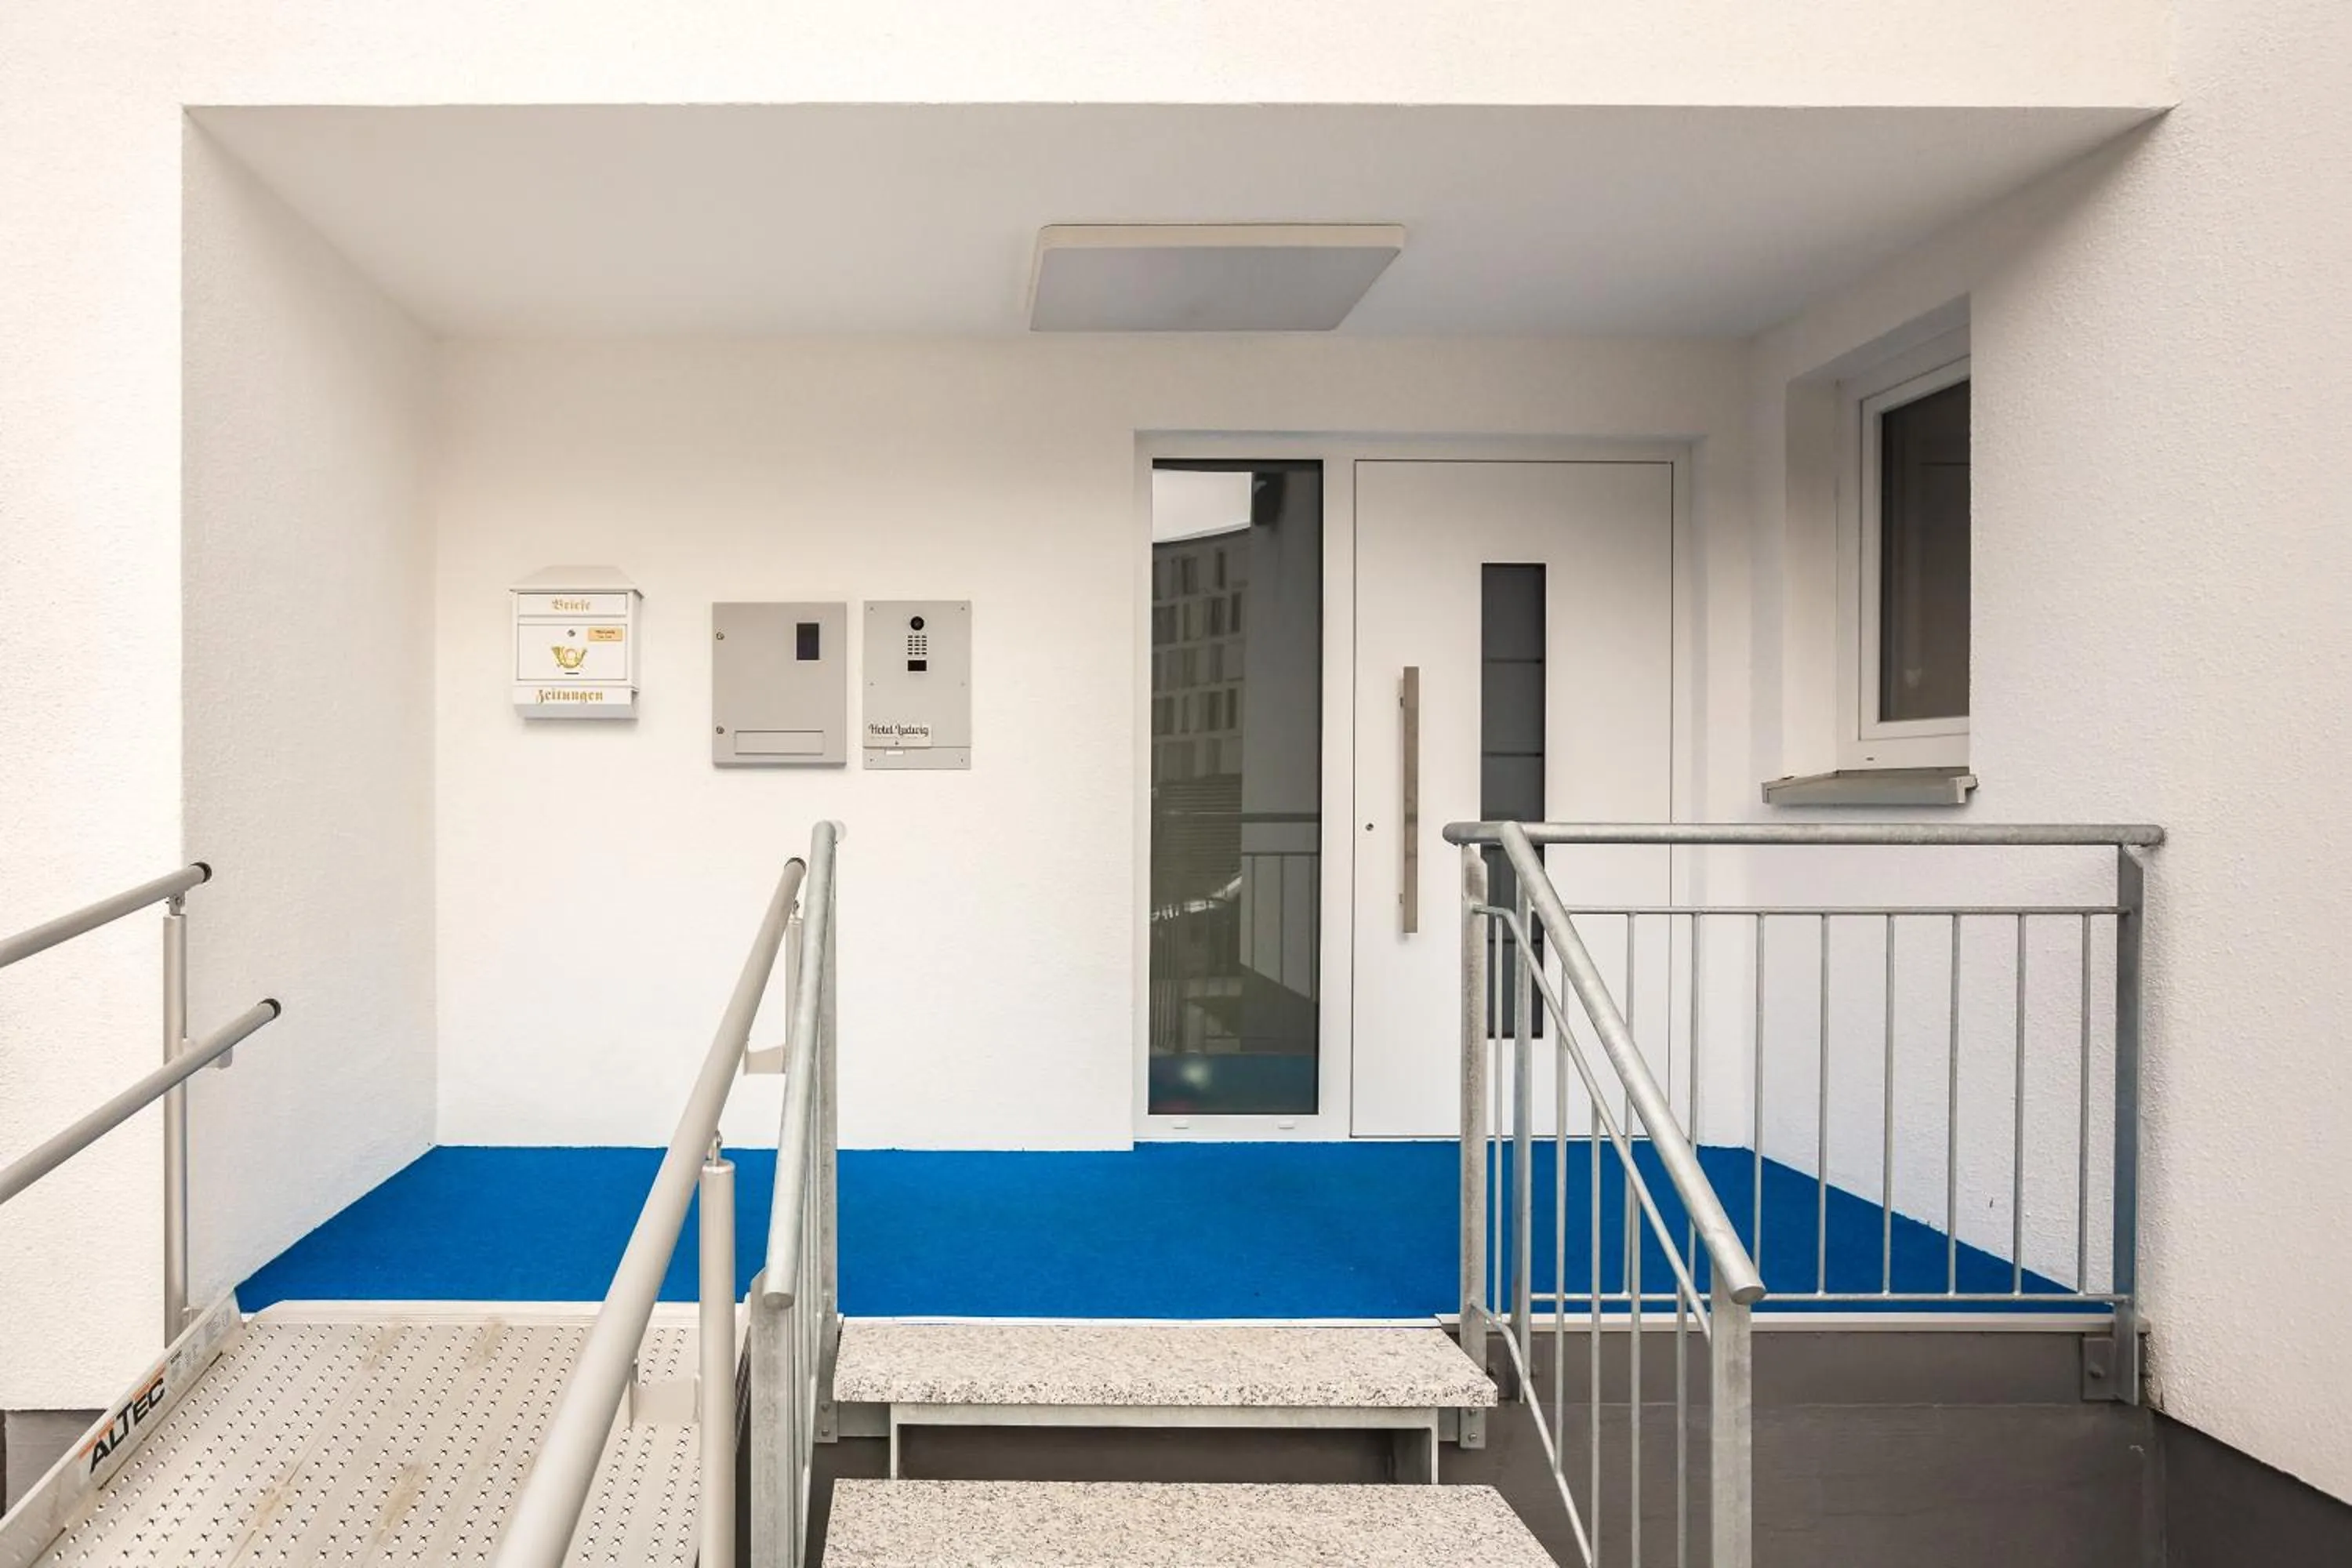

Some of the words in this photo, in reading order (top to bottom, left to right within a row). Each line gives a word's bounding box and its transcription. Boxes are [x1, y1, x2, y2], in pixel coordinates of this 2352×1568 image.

[552, 598, 590, 611] Briefe
[536, 688, 603, 703] Zeitungen
[868, 724, 893, 735] Hotel
[895, 724, 928, 738] Ludwig
